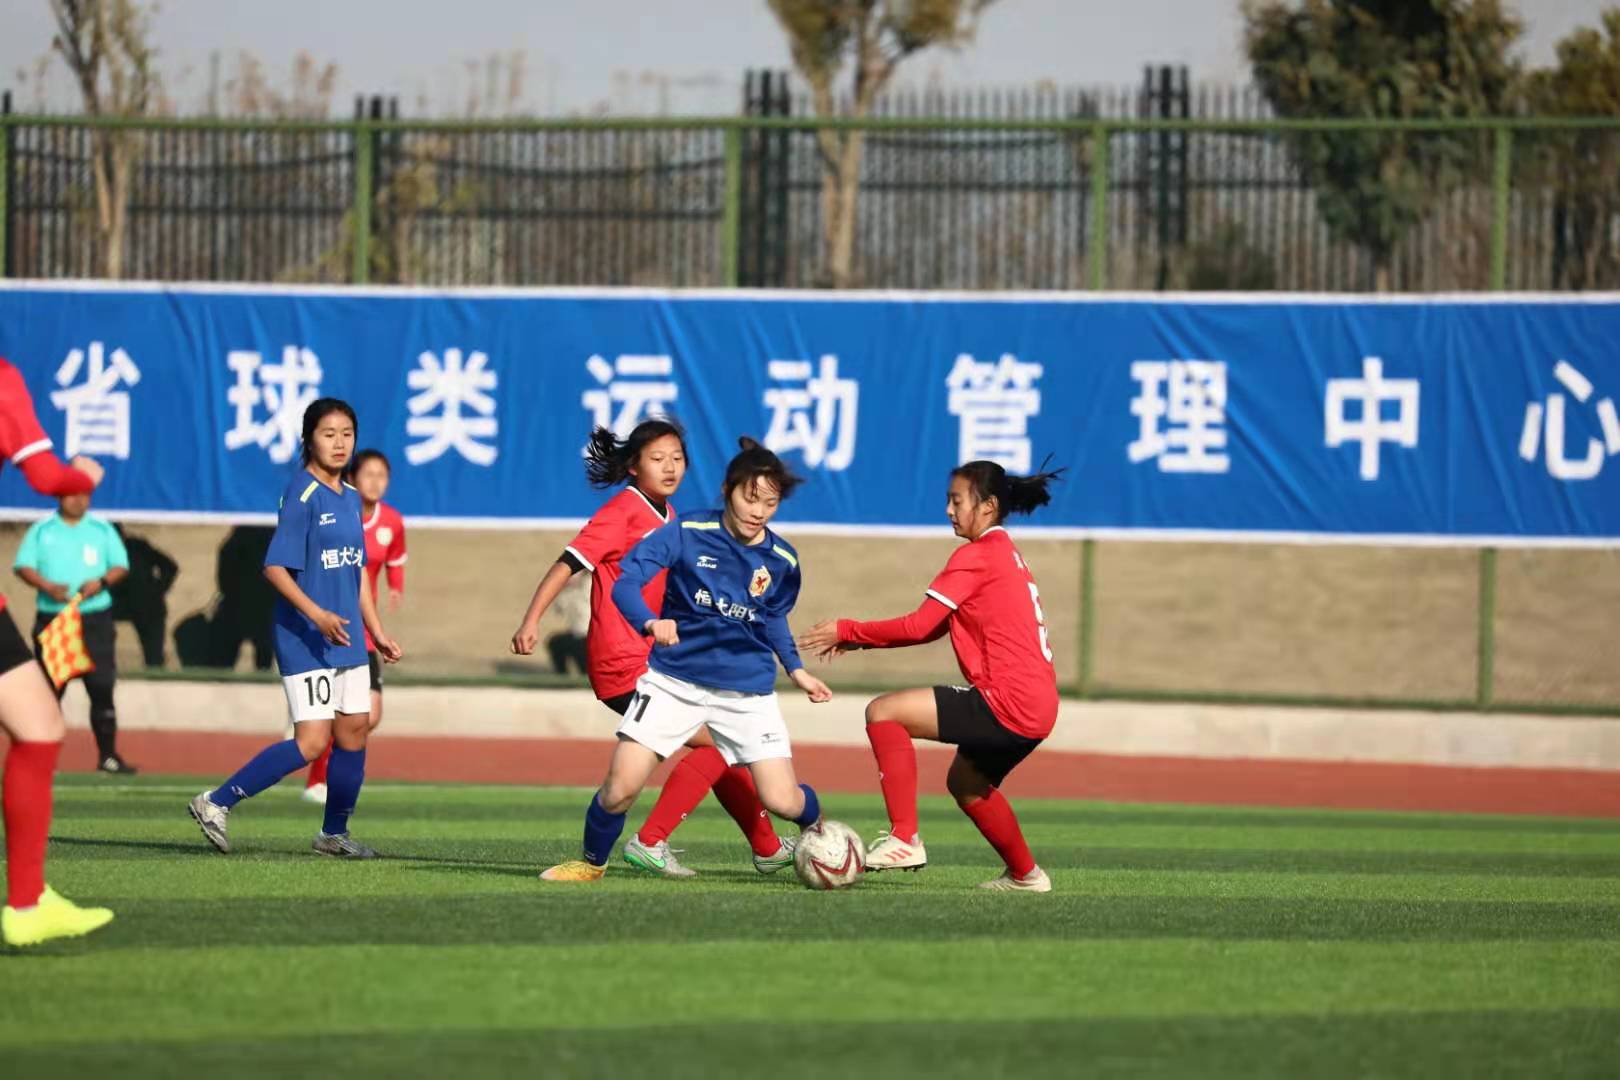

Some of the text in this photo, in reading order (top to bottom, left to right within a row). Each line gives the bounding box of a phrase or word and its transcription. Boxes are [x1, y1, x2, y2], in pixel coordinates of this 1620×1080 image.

[50, 341, 1620, 481] 省球类运动管理中心
[304, 675, 330, 706] 10
